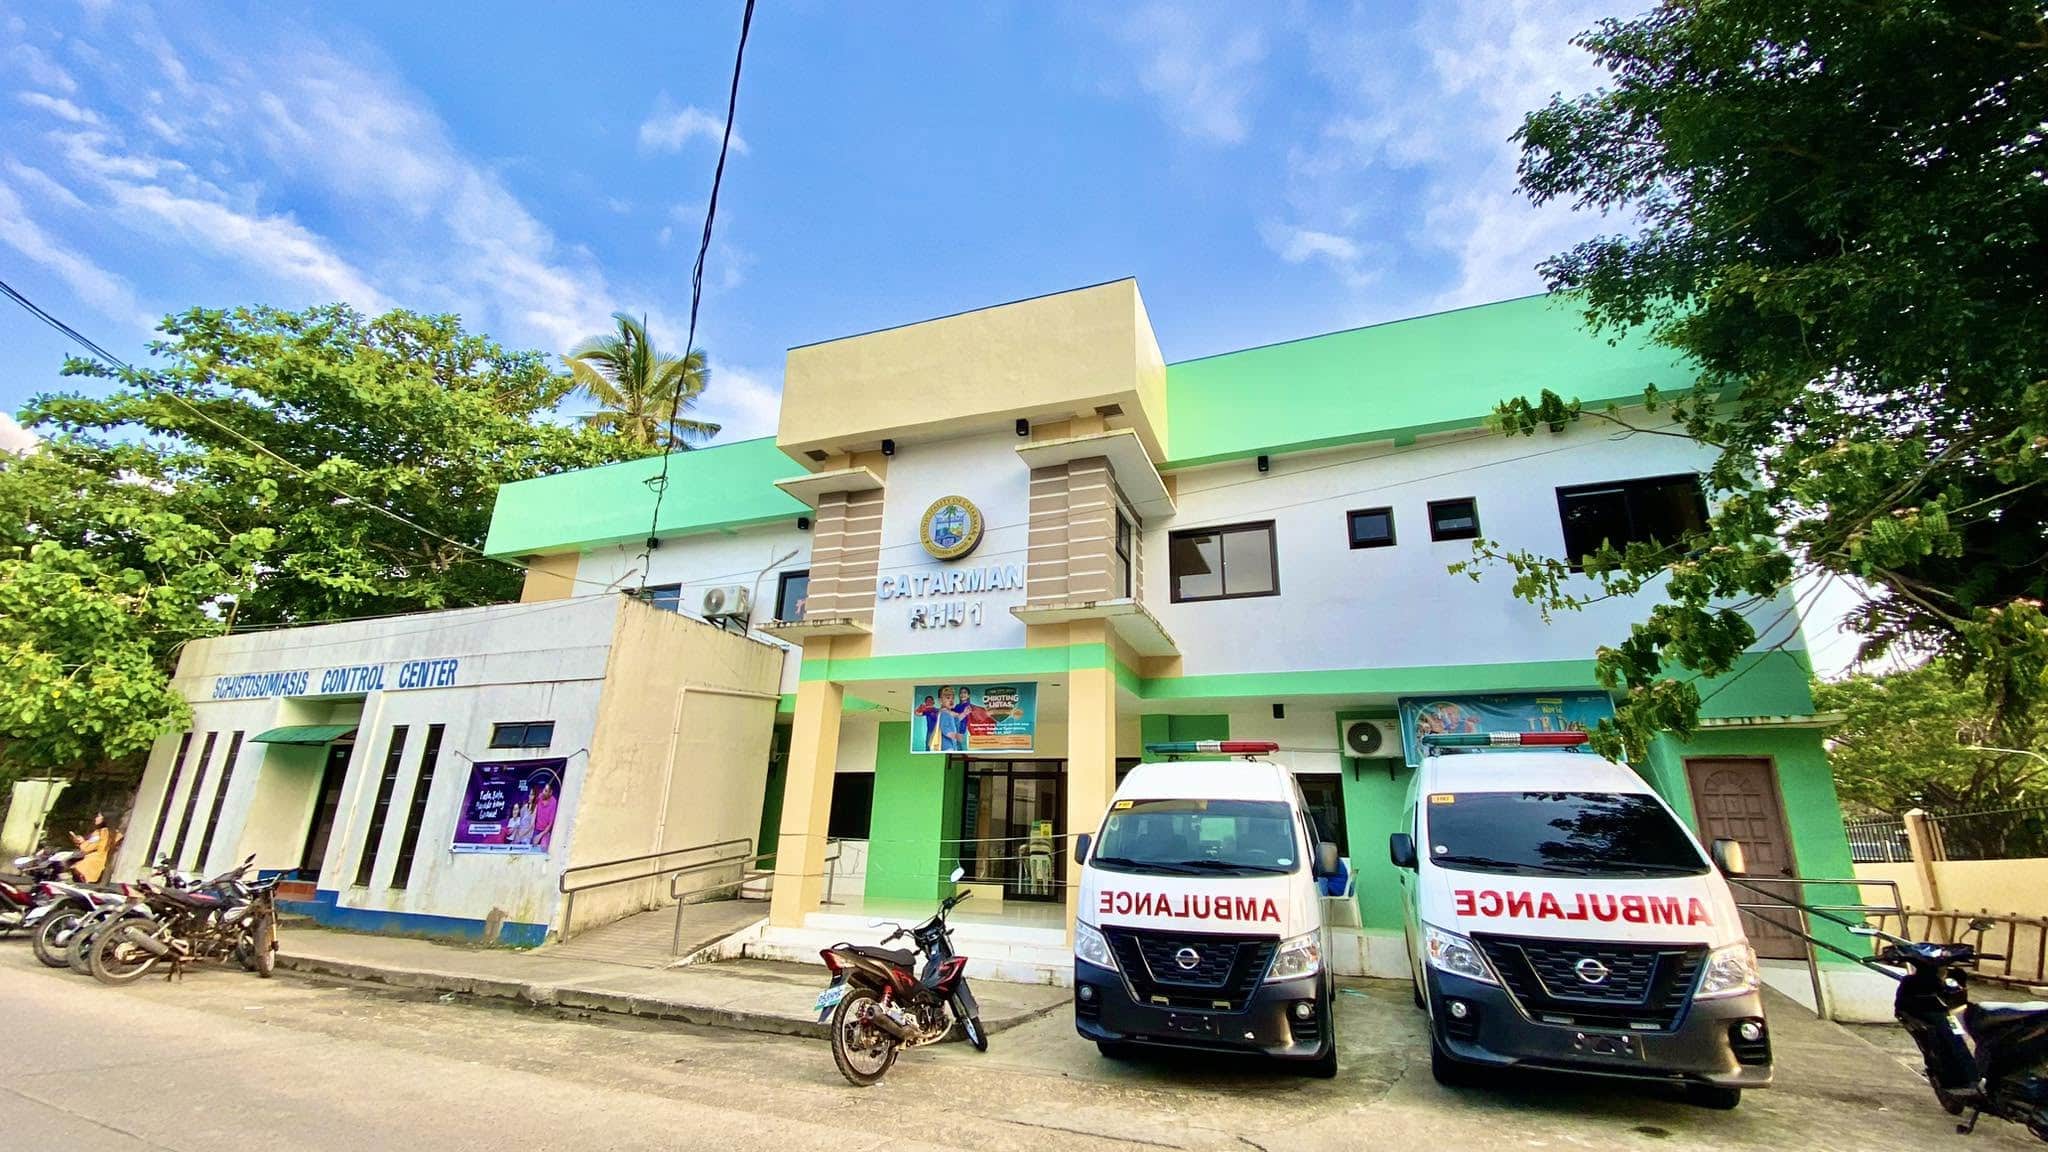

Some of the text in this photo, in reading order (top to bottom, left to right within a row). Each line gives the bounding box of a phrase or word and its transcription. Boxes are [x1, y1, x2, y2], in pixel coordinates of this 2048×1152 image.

[877, 564, 1025, 600] CATARMAN
[910, 600, 983, 630] RHU 1
[212, 658, 459, 699] SCHISTOSOMIASIS CONTROL CENTER
